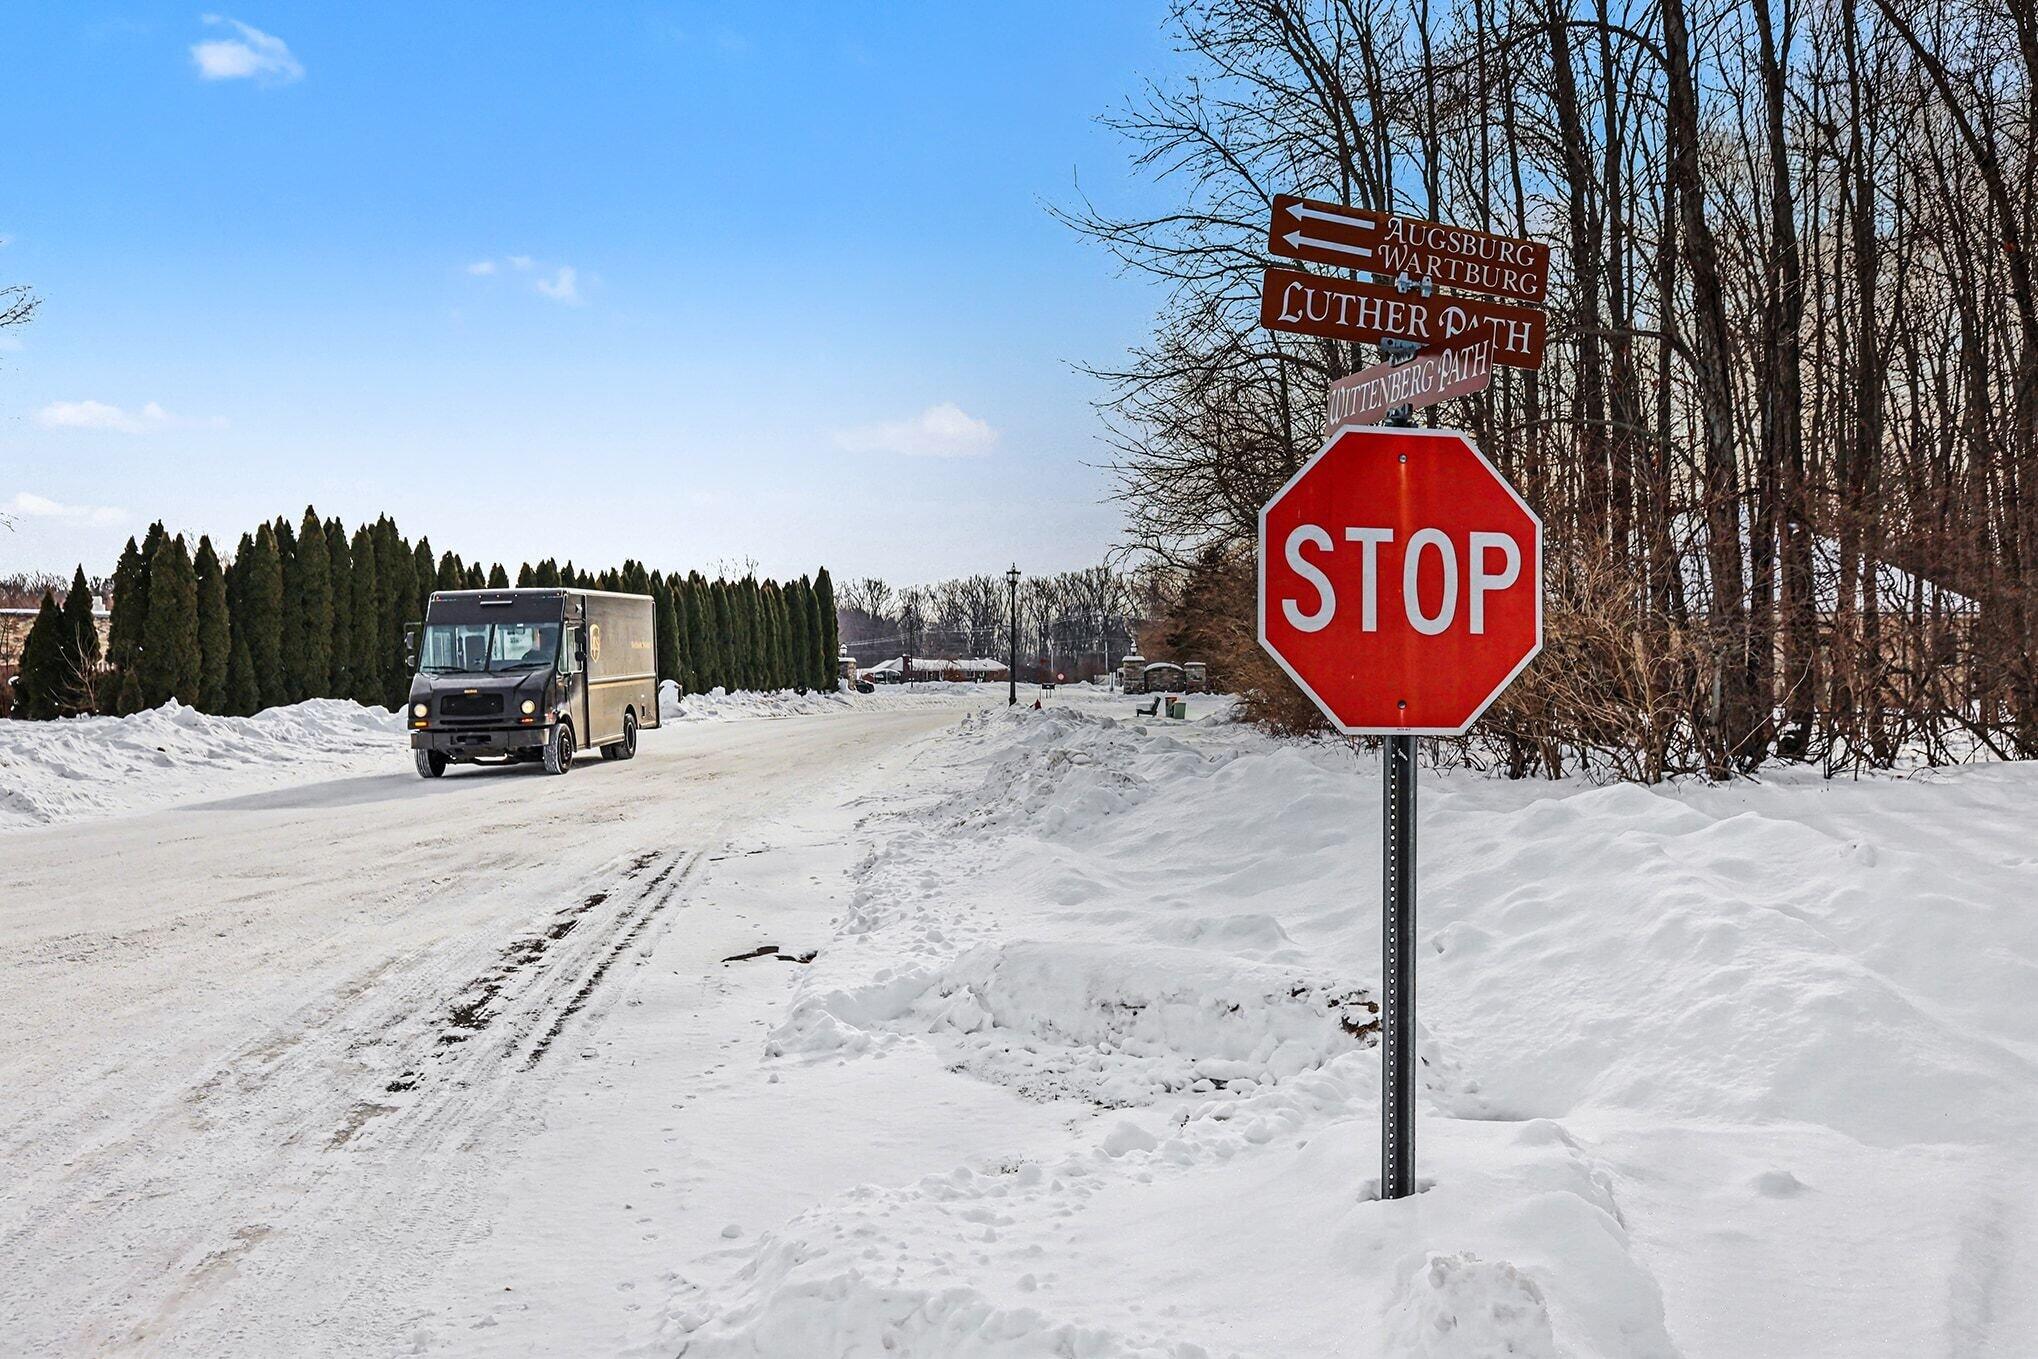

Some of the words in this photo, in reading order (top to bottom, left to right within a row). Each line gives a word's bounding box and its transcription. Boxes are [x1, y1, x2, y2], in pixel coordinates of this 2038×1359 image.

[1378, 243, 1538, 294] WARTBURG
[1385, 217, 1535, 266] AUGSBURG
[1277, 281, 1430, 338] LUTHER
[1329, 360, 1435, 426] WITTENBERG
[1437, 339, 1489, 393] PATH
[1281, 523, 1521, 636] STOP
